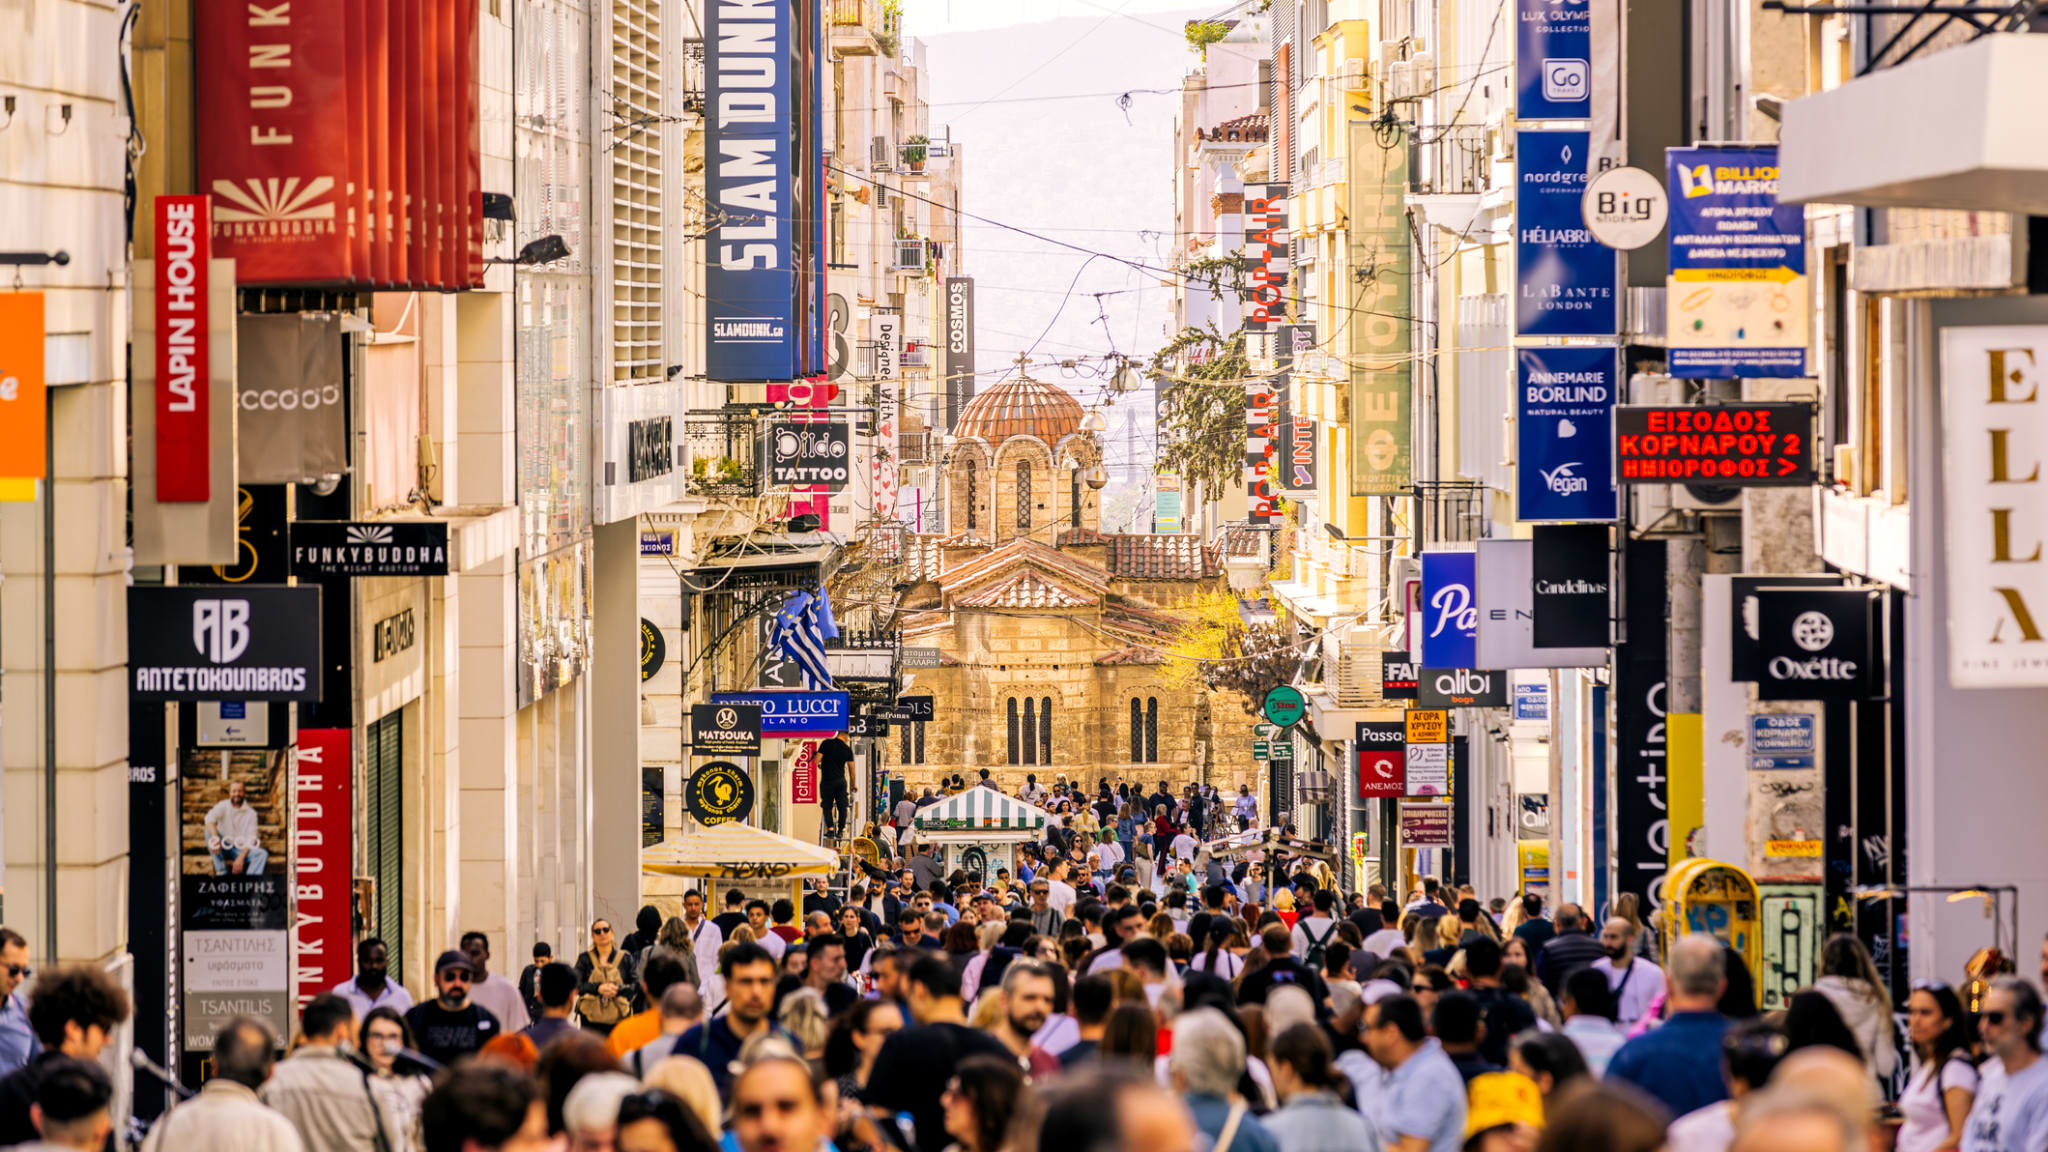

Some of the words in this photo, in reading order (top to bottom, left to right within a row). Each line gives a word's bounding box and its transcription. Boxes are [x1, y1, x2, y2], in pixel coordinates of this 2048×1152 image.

[1598, 191, 1651, 220] Big
[168, 203, 195, 311] HOUSE
[1537, 301, 1593, 311] LONDON
[169, 318, 196, 412] LAPIN
[1647, 410, 1771, 432] ΕΙΣΟΔΟΣ
[1620, 433, 1776, 456] ΚΟΡΝΑΡΟΥ
[1783, 434, 1801, 456] 2
[774, 467, 848, 481] TATTOO
[295, 546, 444, 564] FUNKYBUDDHA
[137, 667, 307, 692] ANTETOKOUNBROS
[1435, 668, 1490, 695] alibi
[787, 699, 839, 714] LUCCI
[698, 730, 754, 741] MATSOUKA
[1362, 727, 1405, 744] Passa
[200, 999, 273, 1015] TSANTILIS
